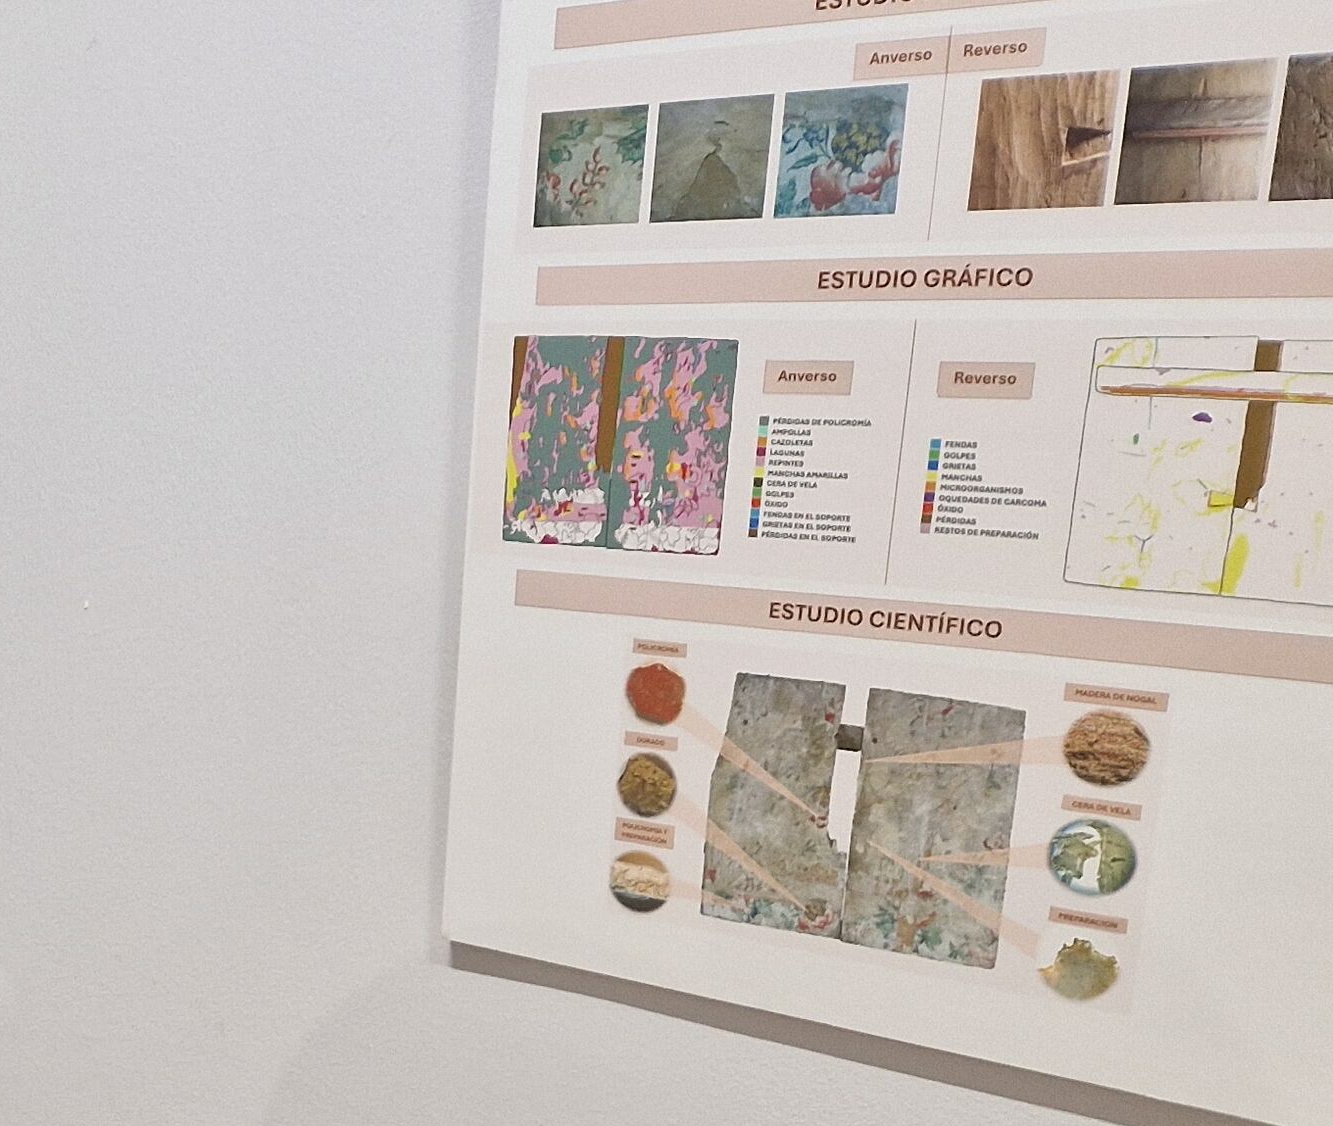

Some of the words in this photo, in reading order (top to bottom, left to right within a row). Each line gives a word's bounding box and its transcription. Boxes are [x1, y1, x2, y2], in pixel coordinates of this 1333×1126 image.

[963, 42, 1028, 58] Reverso
[869, 50, 933, 66] Anverso
[817, 269, 918, 290] ESTUDIO
[923, 263, 1034, 288] GRÁFICO
[777, 369, 838, 382] Anverso
[954, 371, 1017, 385] Reverso
[771, 428, 812, 436] AMPOLLAS
[769, 448, 805, 457] LAGUNAS
[943, 451, 976, 460] GOLPES
[942, 462, 976, 471] GRIETAS
[941, 473, 983, 482] MANCHAS
[799, 481, 818, 489] VELA
[940, 484, 1024, 495] MICROORGANISMOS
[938, 494, 990, 504] OQUEDADES
[991, 497, 1002, 505] DE
[1004, 498, 1047, 507] CARCOMA
[815, 513, 851, 523] SOPORTE
[935, 515, 977, 525] PÉRDIDAS
[816, 523, 851, 533] SOPORTE
[934, 525, 966, 535] RESTOS
[967, 528, 978, 536] DE
[979, 527, 1040, 540] PREPARACIÓN
[821, 534, 856, 543] SOPORTE
[769, 601, 864, 627] ESTUDIO
[869, 611, 1003, 639] CIENTÍFICO
[1075, 687, 1111, 700] MADERA
[1112, 692, 1125, 701] DE
[1126, 694, 1158, 705] NOGAL
[1071, 800, 1095, 811] CERA
[1096, 803, 1108, 813] DE
[1110, 806, 1132, 816] VELA
